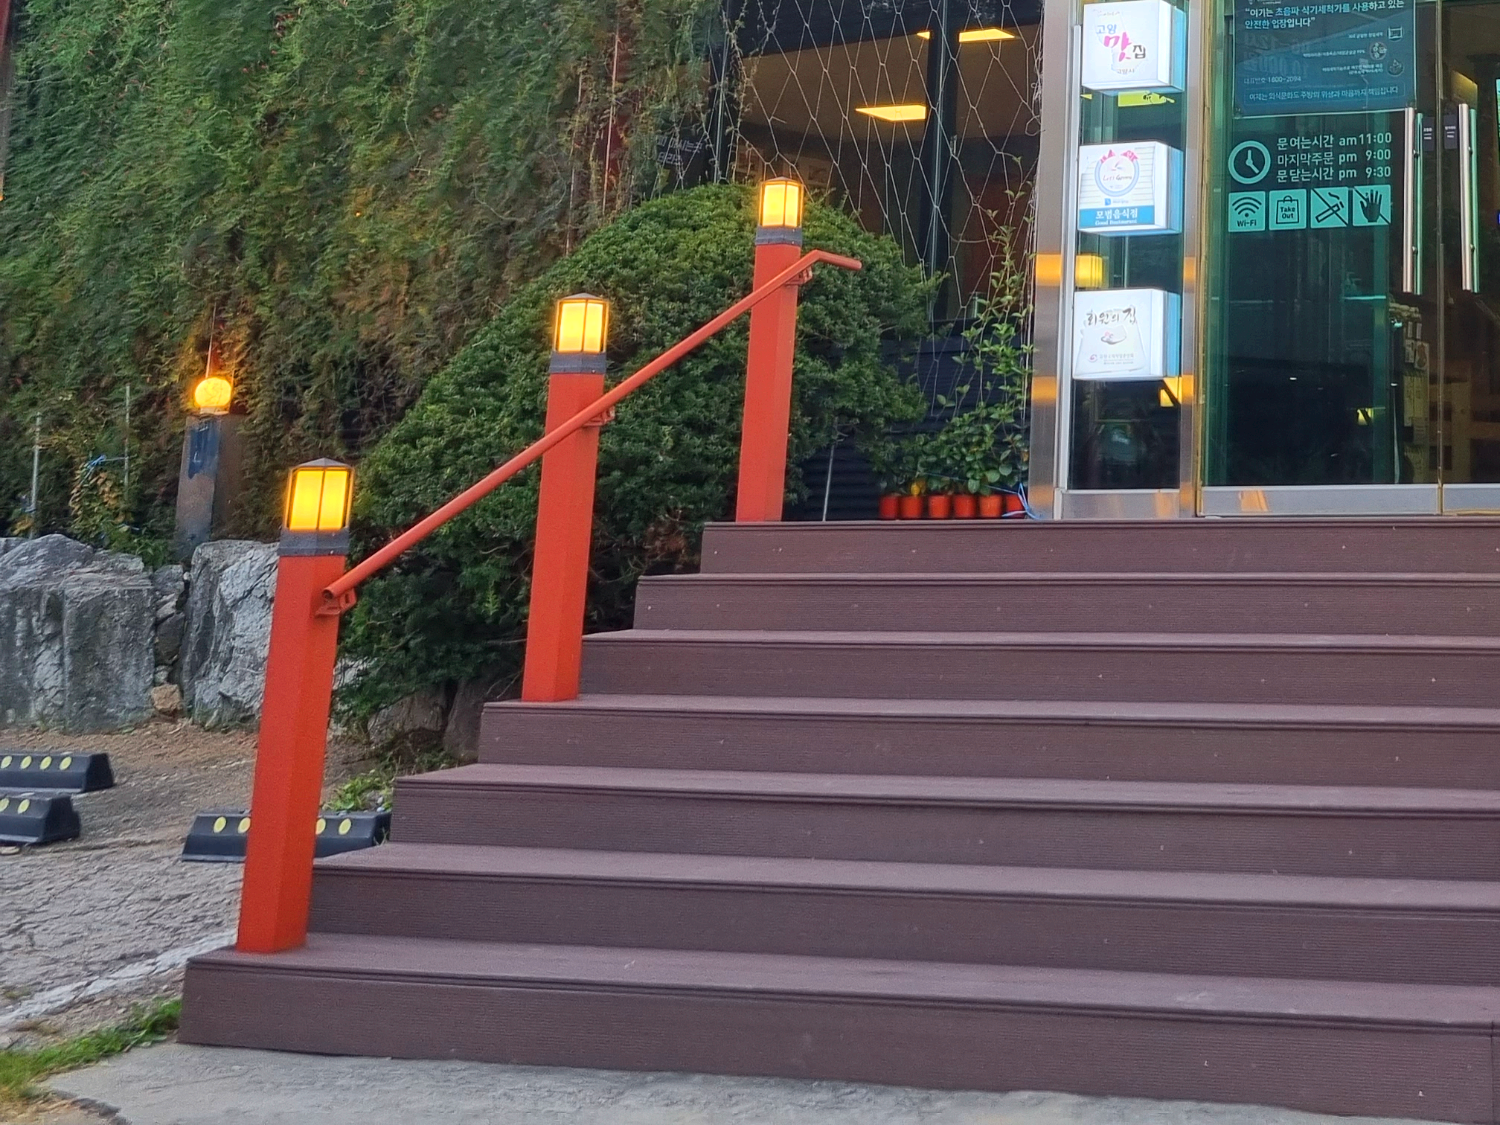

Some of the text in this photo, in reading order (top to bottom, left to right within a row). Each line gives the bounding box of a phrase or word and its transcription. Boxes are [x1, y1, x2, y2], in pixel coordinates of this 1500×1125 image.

[1275, 5, 1300, 17] 초음파
[1352, 1, 1386, 12] 사용하고
[1096, 24, 1117, 35] 고양
[1245, 19, 1270, 30] 안전한
[1277, 148, 1391, 167] 마지막주문 pm 9:00
[1338, 168, 1357, 181] pm
[1365, 166, 1391, 178] 9:30
[1095, 207, 1138, 220] 모범음식점
[1236, 219, 1257, 227] Wi-Fi
[1085, 306, 1137, 326] 회원의 집
